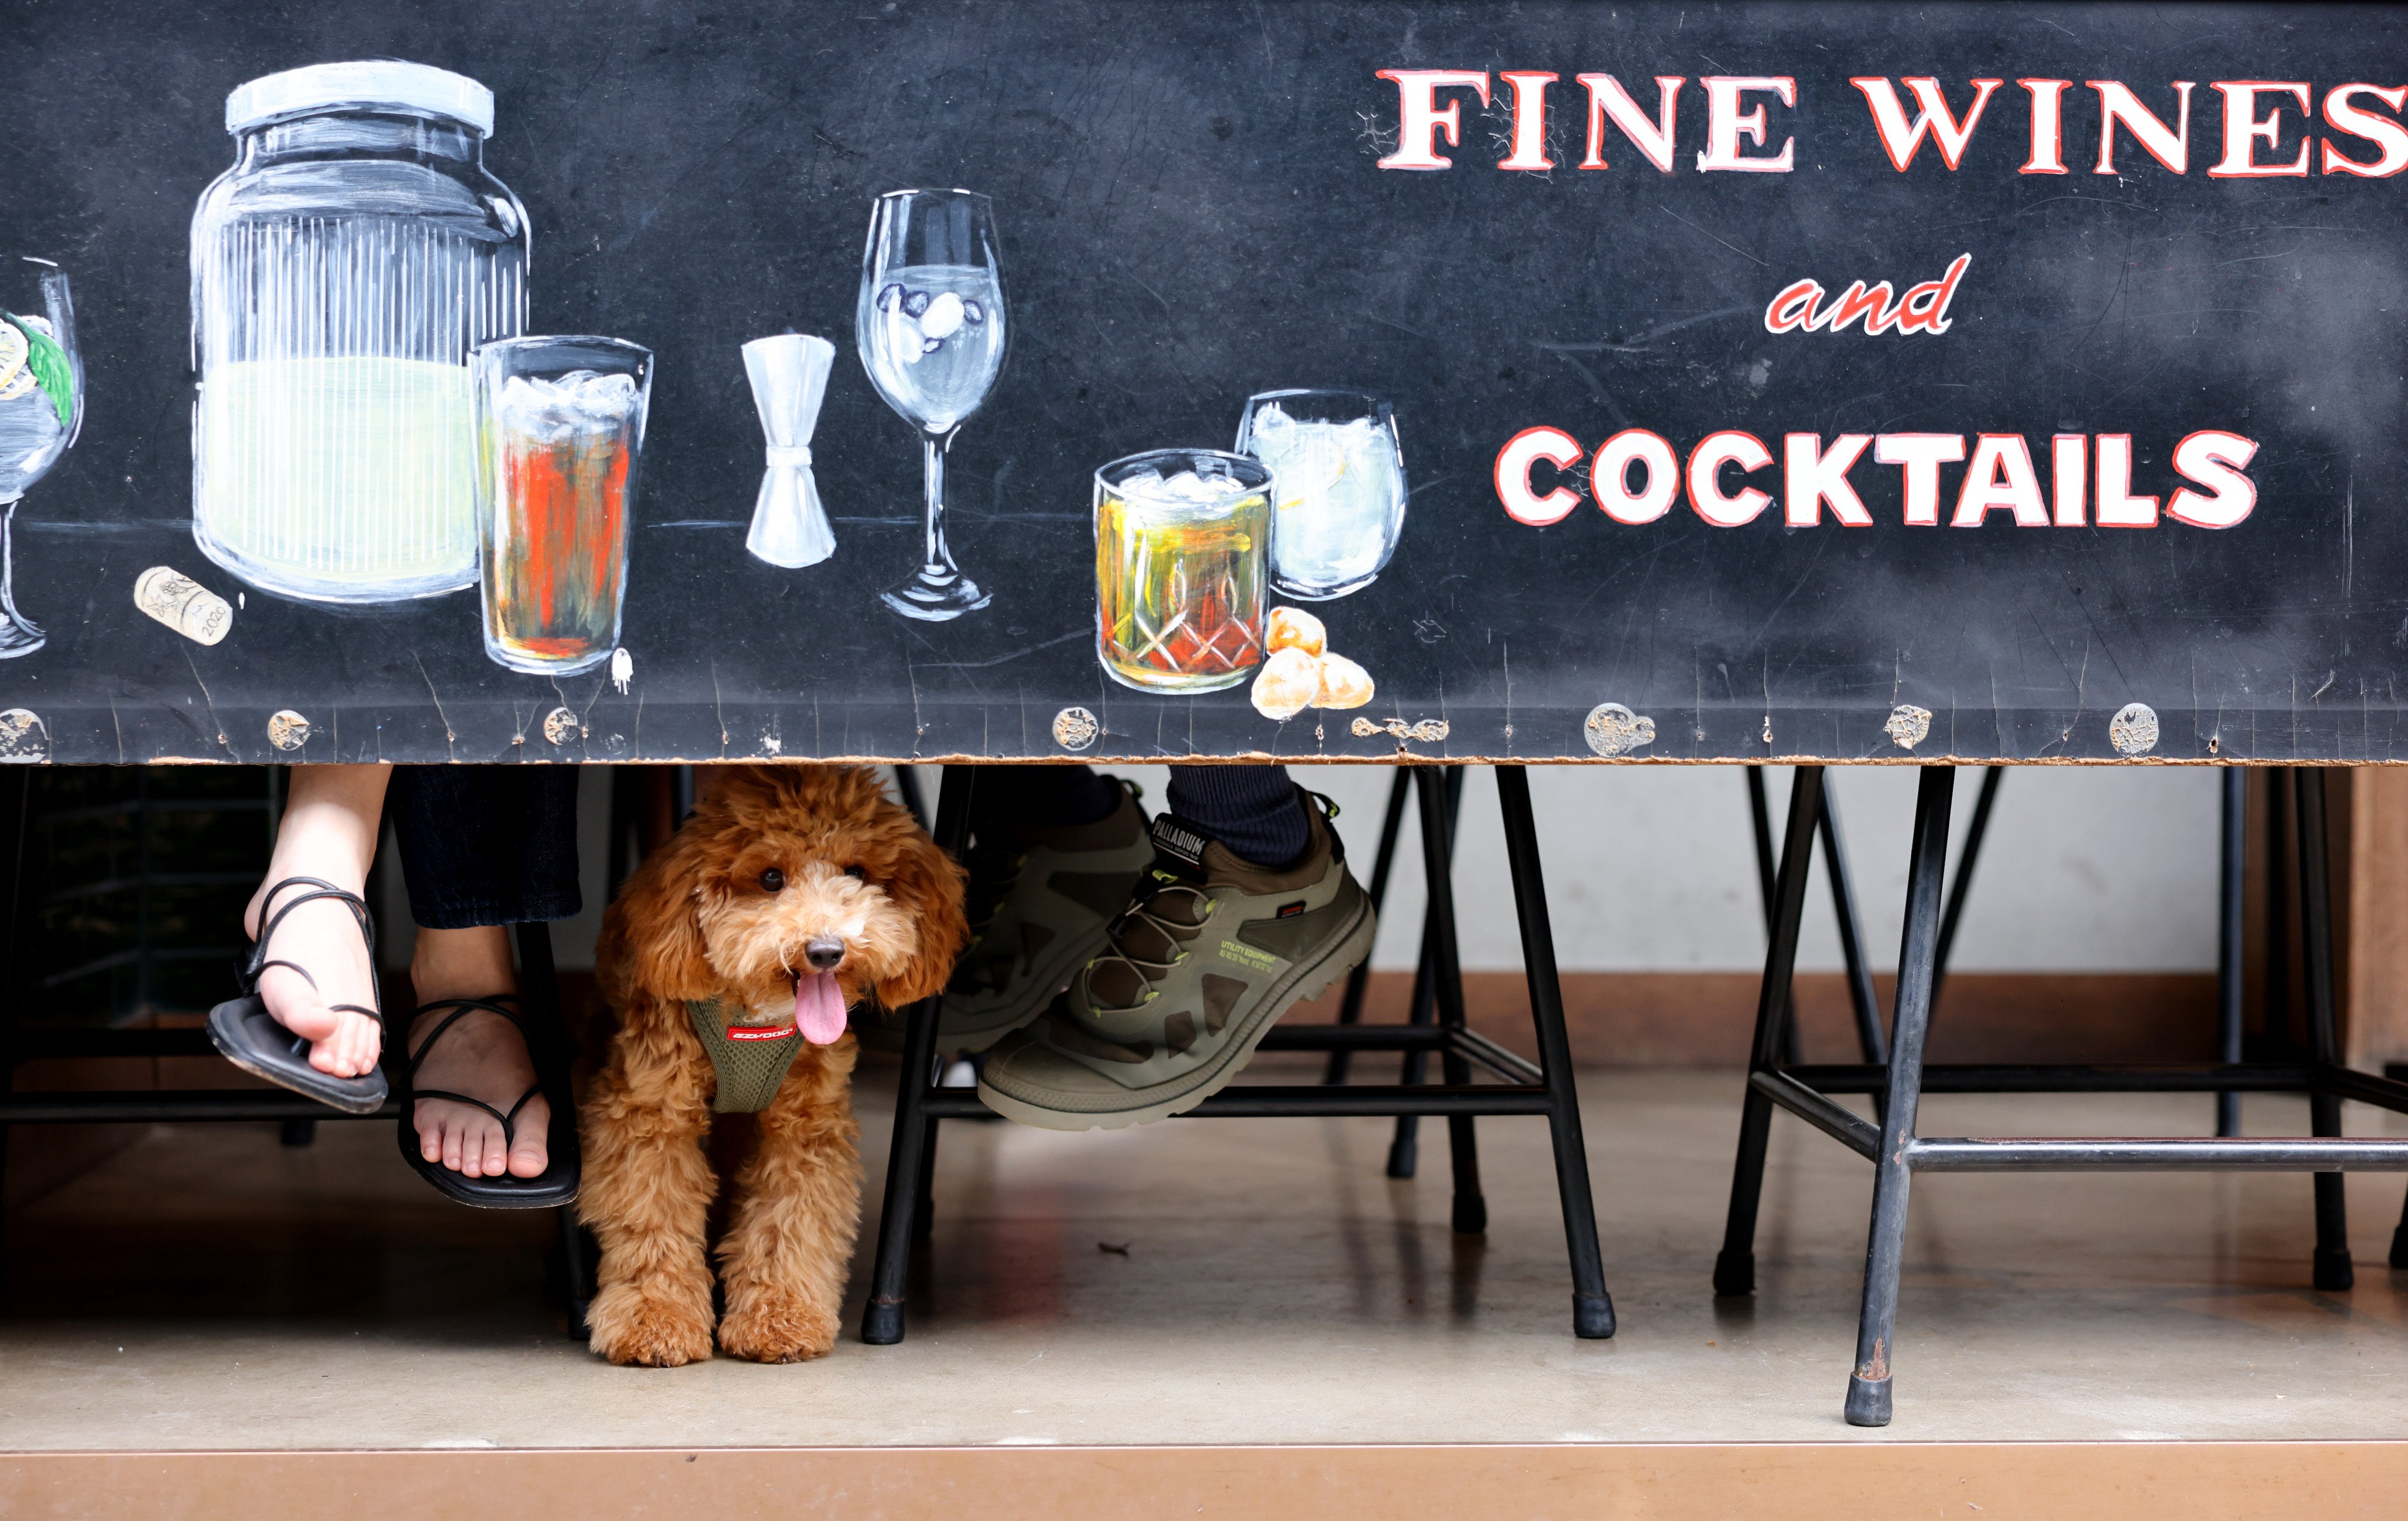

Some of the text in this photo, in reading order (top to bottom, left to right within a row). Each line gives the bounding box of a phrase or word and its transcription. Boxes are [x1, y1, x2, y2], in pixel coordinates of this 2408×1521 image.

[1375, 68, 2408, 178] FINE WINES
[1764, 252, 1972, 336] and
[1494, 426, 2259, 530] COCKTAILS
[202, 606, 226, 637] 2020
[1152, 819, 1206, 856] PALLADIUM
[1221, 940, 1245, 954] UTILITY
[1244, 948, 1277, 965] EQUIPMENT
